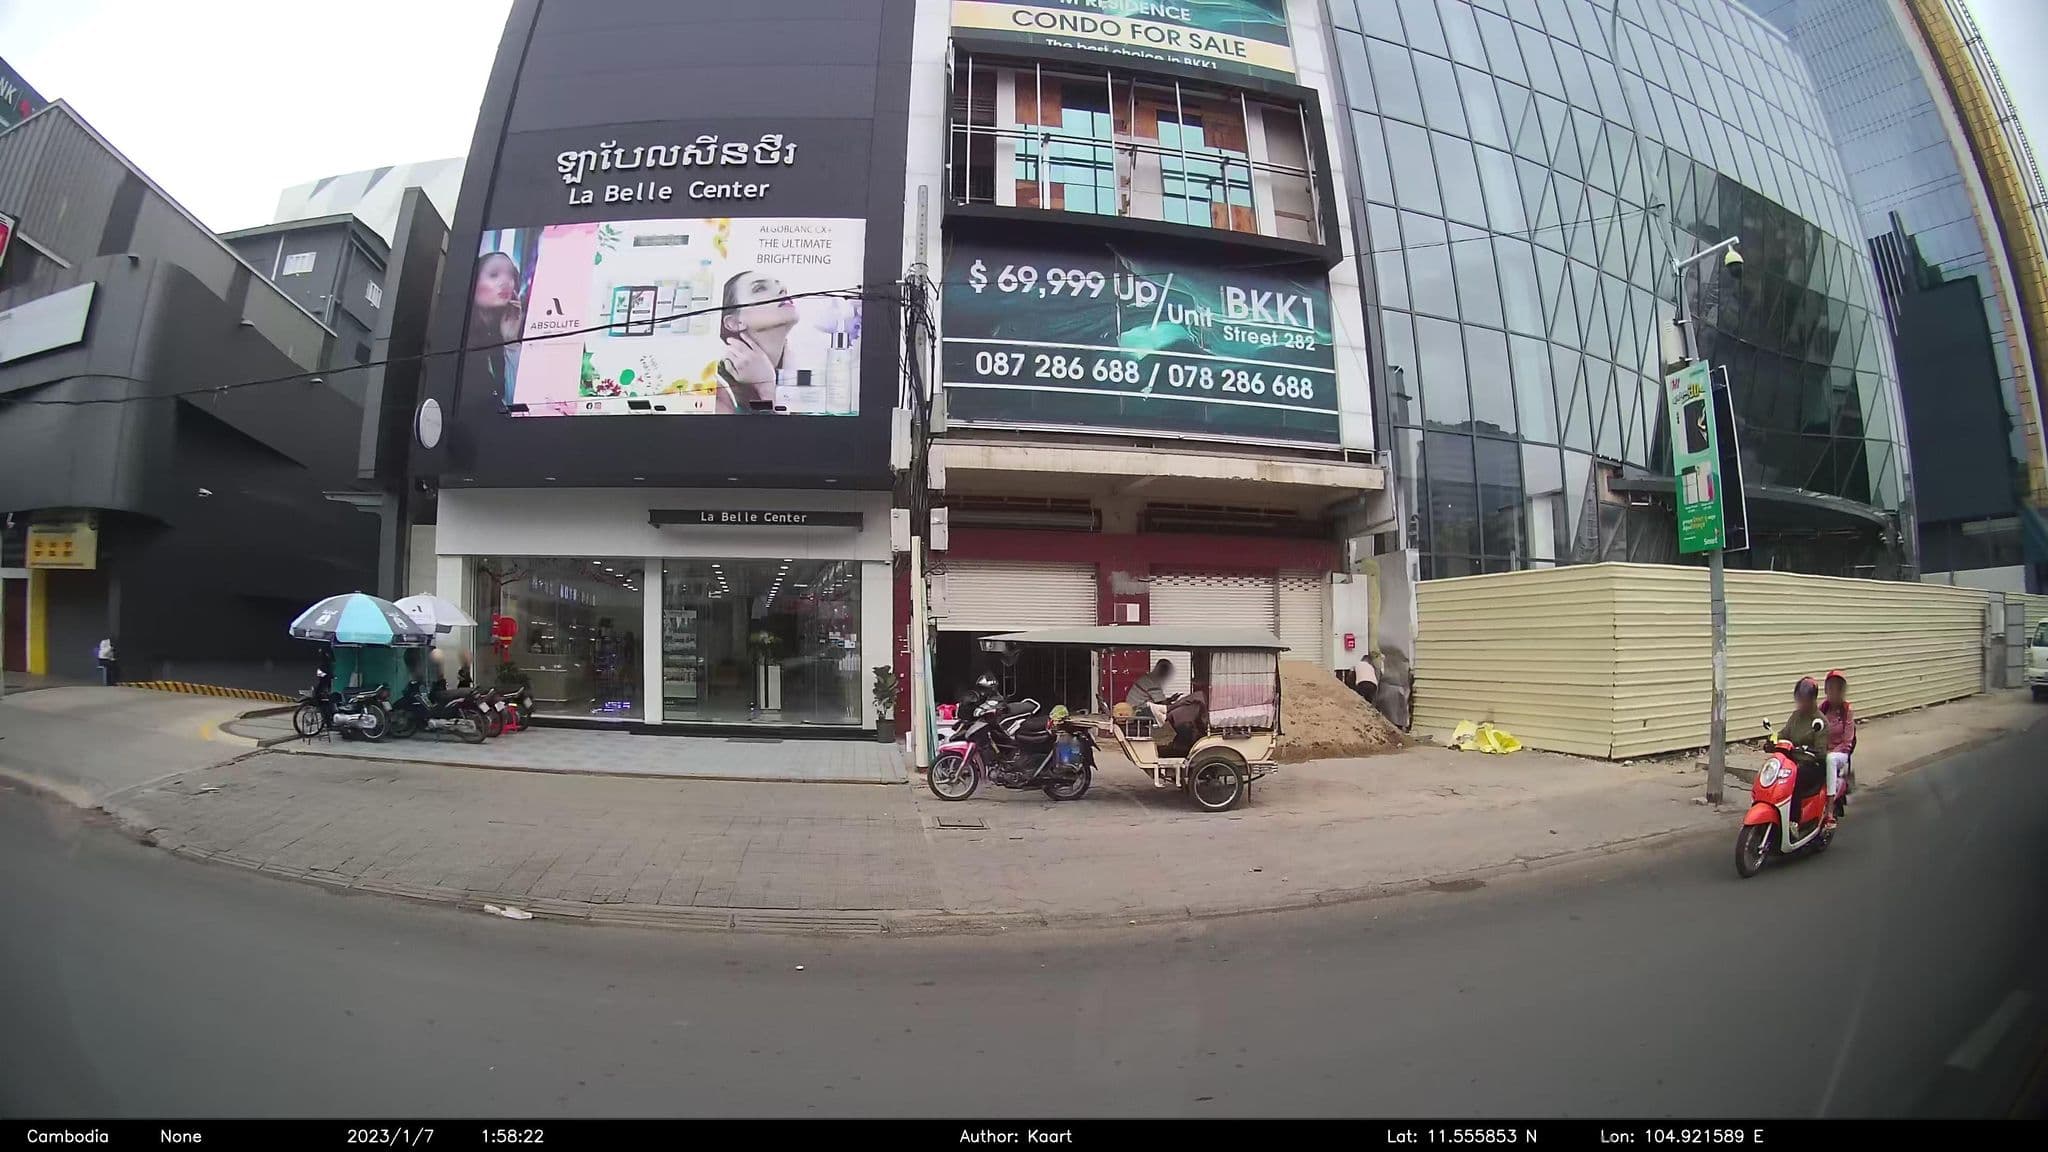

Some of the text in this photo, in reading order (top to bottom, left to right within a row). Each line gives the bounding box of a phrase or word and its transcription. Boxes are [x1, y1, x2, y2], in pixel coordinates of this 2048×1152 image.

[1012, 9, 1247, 58] CONDO FOR SALE
[568, 180, 770, 205] La Belle Center
[759, 238, 832, 249] THE ULTIMATE
[756, 253, 832, 265] BRIGHTENING
[968, 259, 987, 294] $
[997, 264, 1106, 300] 69,999
[1224, 284, 1315, 330] BKK1
[530, 319, 581, 330] ABSOLUTE
[1223, 325, 1316, 352] Street 282
[975, 351, 1025, 378] 087
[1034, 353, 1085, 381] 286
[1092, 357, 1140, 385] 688
[1168, 363, 1215, 390] 078
[1221, 368, 1266, 396] 286
[1271, 373, 1314, 400] 688
[700, 511, 808, 524] La Belle Center
